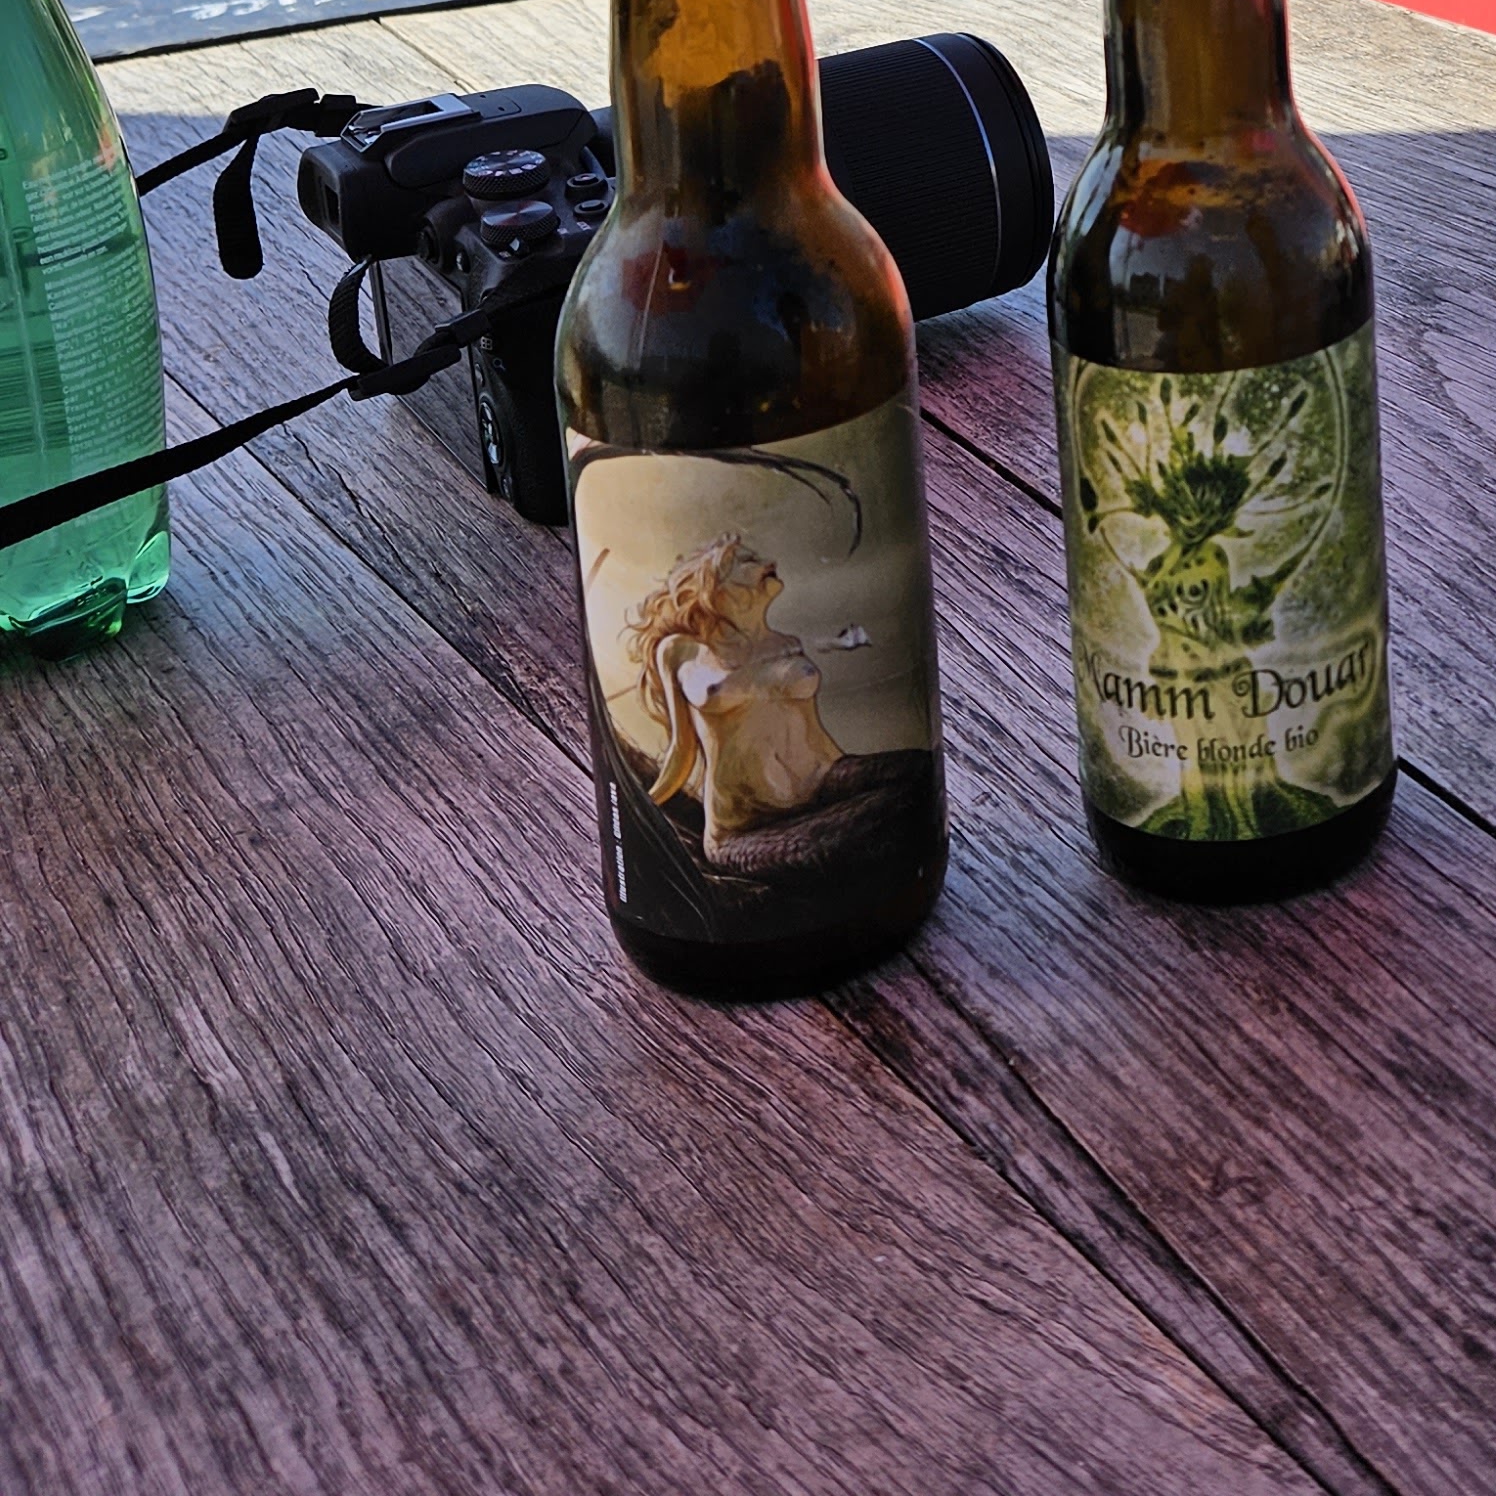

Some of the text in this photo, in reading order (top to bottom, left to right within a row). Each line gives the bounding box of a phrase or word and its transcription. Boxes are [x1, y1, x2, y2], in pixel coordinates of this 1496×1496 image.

[1231, 644, 1369, 718] Douar
[1119, 725, 1319, 763] Bière blonde bio
